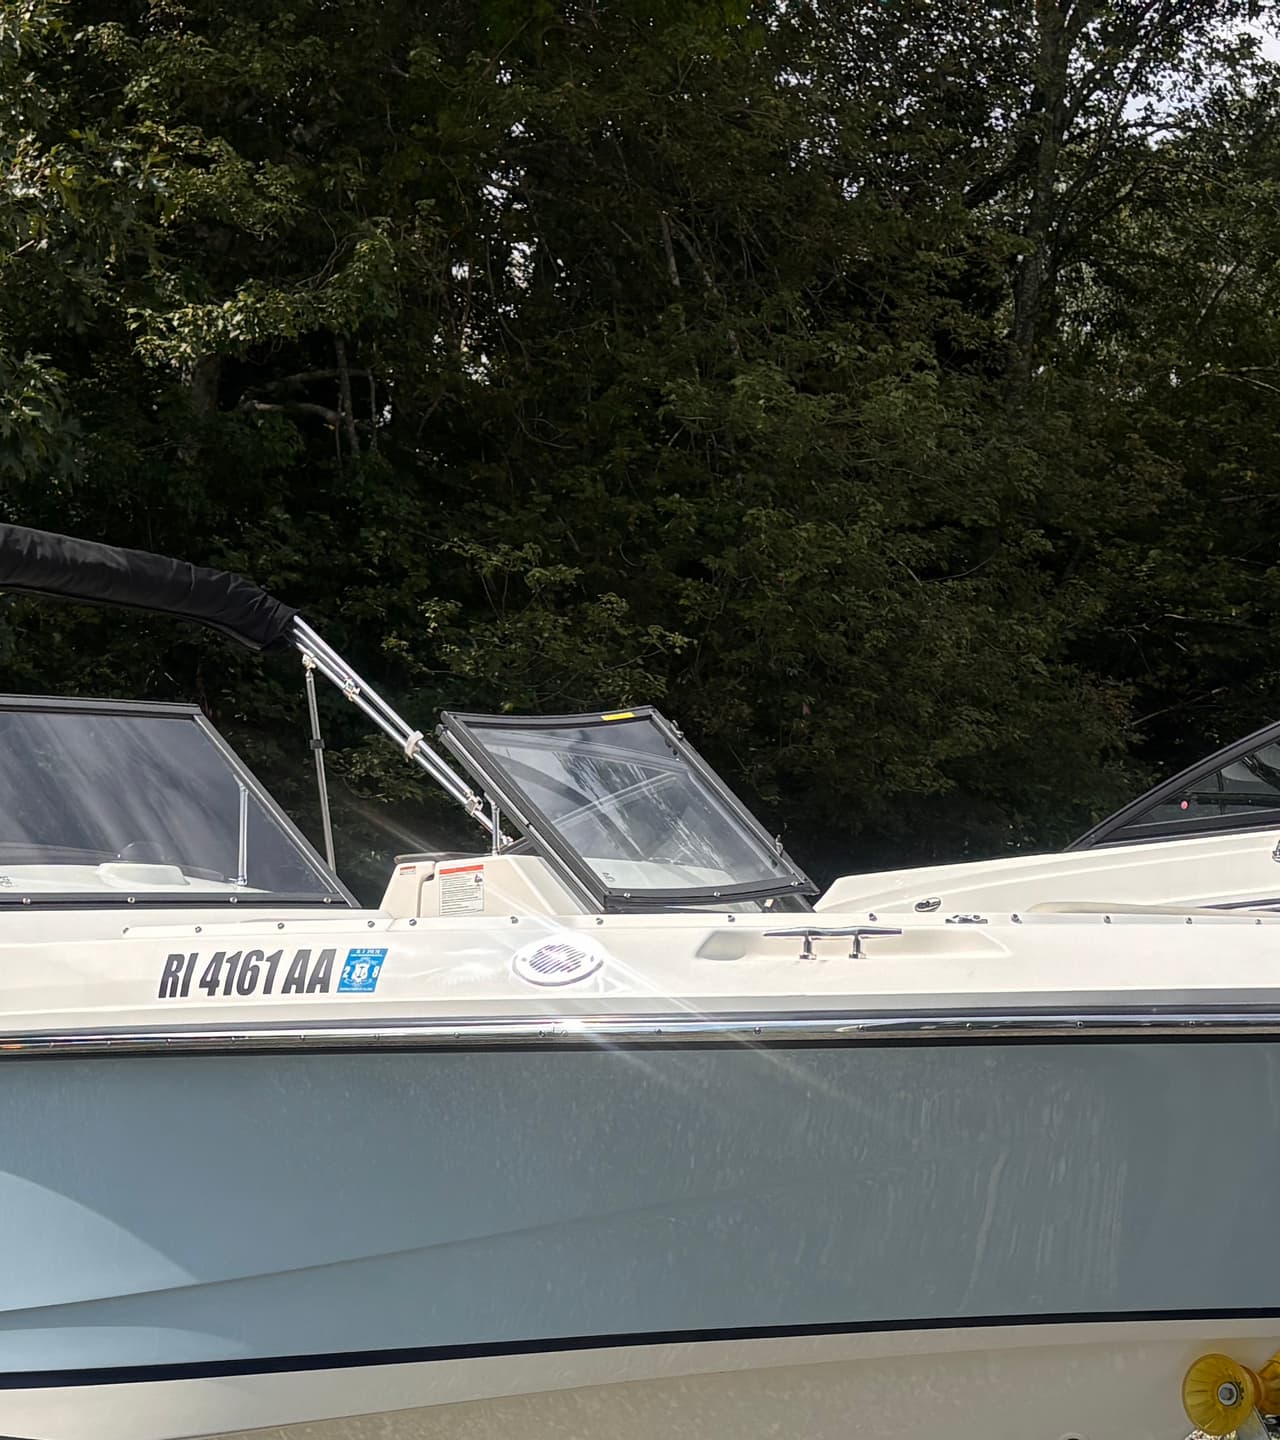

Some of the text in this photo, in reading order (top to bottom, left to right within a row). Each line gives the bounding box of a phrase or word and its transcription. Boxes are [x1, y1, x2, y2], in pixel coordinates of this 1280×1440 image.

[158, 948, 337, 998] RI 4161 AA
